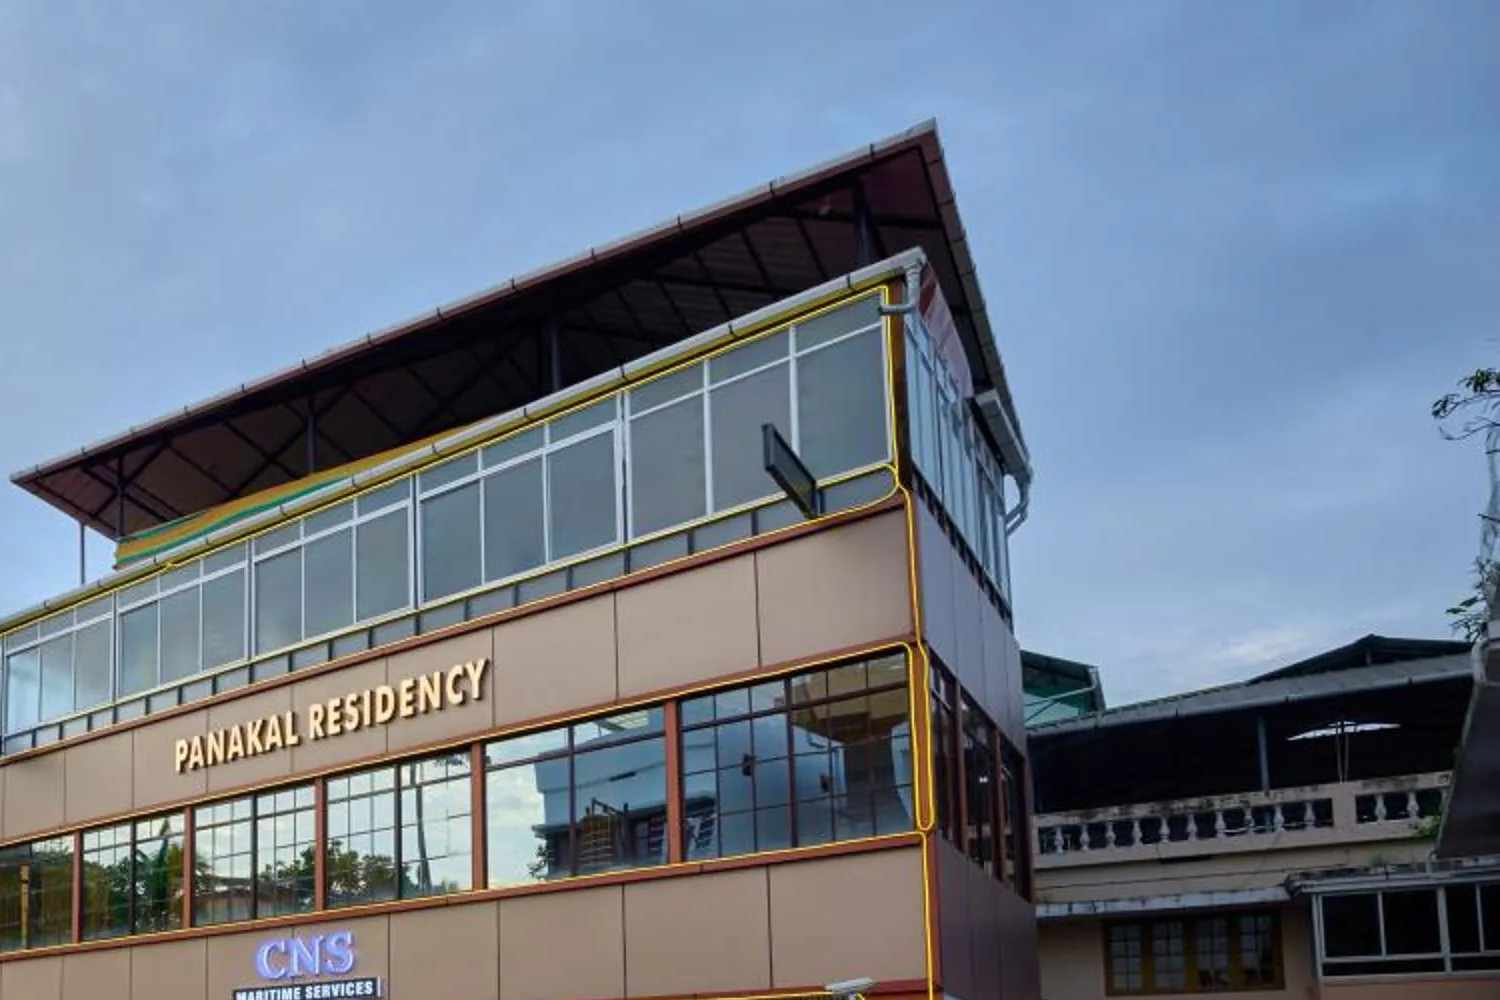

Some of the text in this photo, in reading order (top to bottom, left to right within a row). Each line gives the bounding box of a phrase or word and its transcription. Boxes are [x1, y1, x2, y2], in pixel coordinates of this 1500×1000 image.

[175, 658, 488, 773] PANAKAL RESIDENCY
[257, 931, 354, 979] CNS
[305, 980, 373, 999] SERVICES
